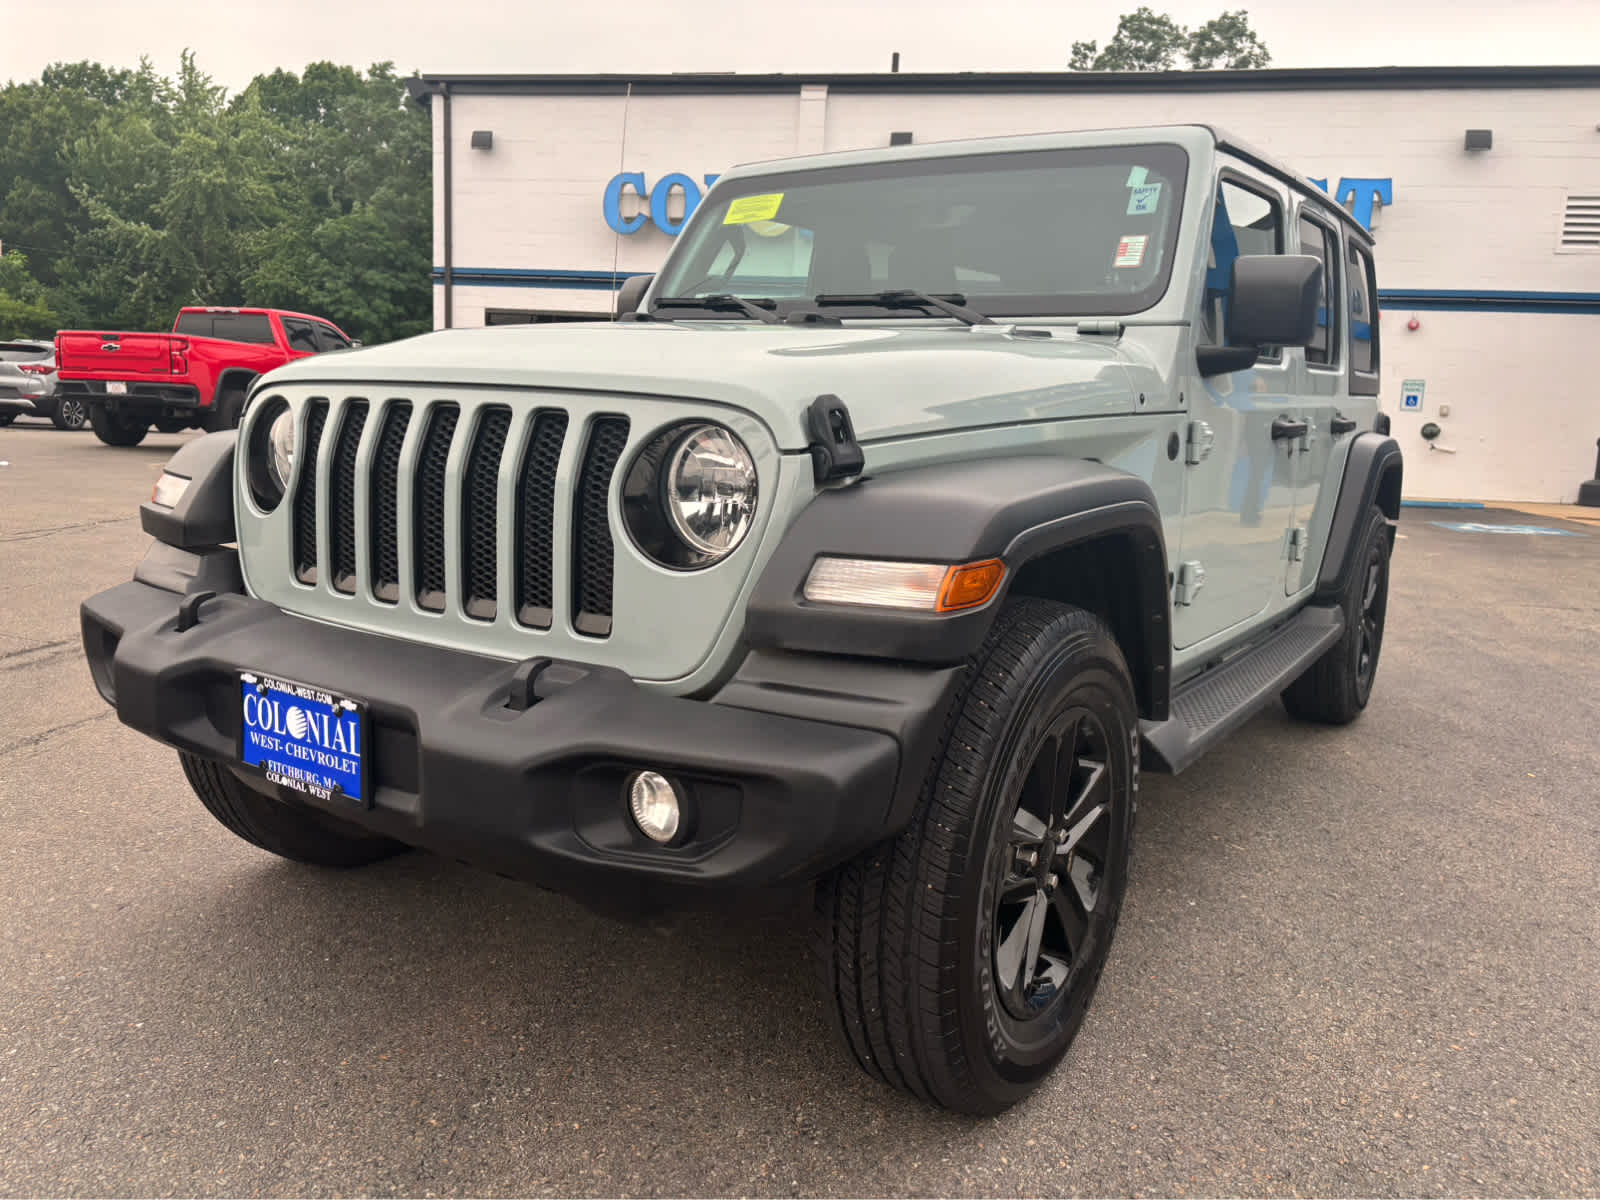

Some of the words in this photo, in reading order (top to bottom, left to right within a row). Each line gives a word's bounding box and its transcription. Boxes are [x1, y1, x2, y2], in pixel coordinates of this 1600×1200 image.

[603, 171, 721, 236] CO
[264, 678, 333, 705] COLONIAL-WEST.COM
[243, 693, 361, 757] COLONIAL
[285, 742, 358, 775] CHEVROLET
[266, 771, 307, 793] COLONIAL
[308, 784, 331, 801] WEST
